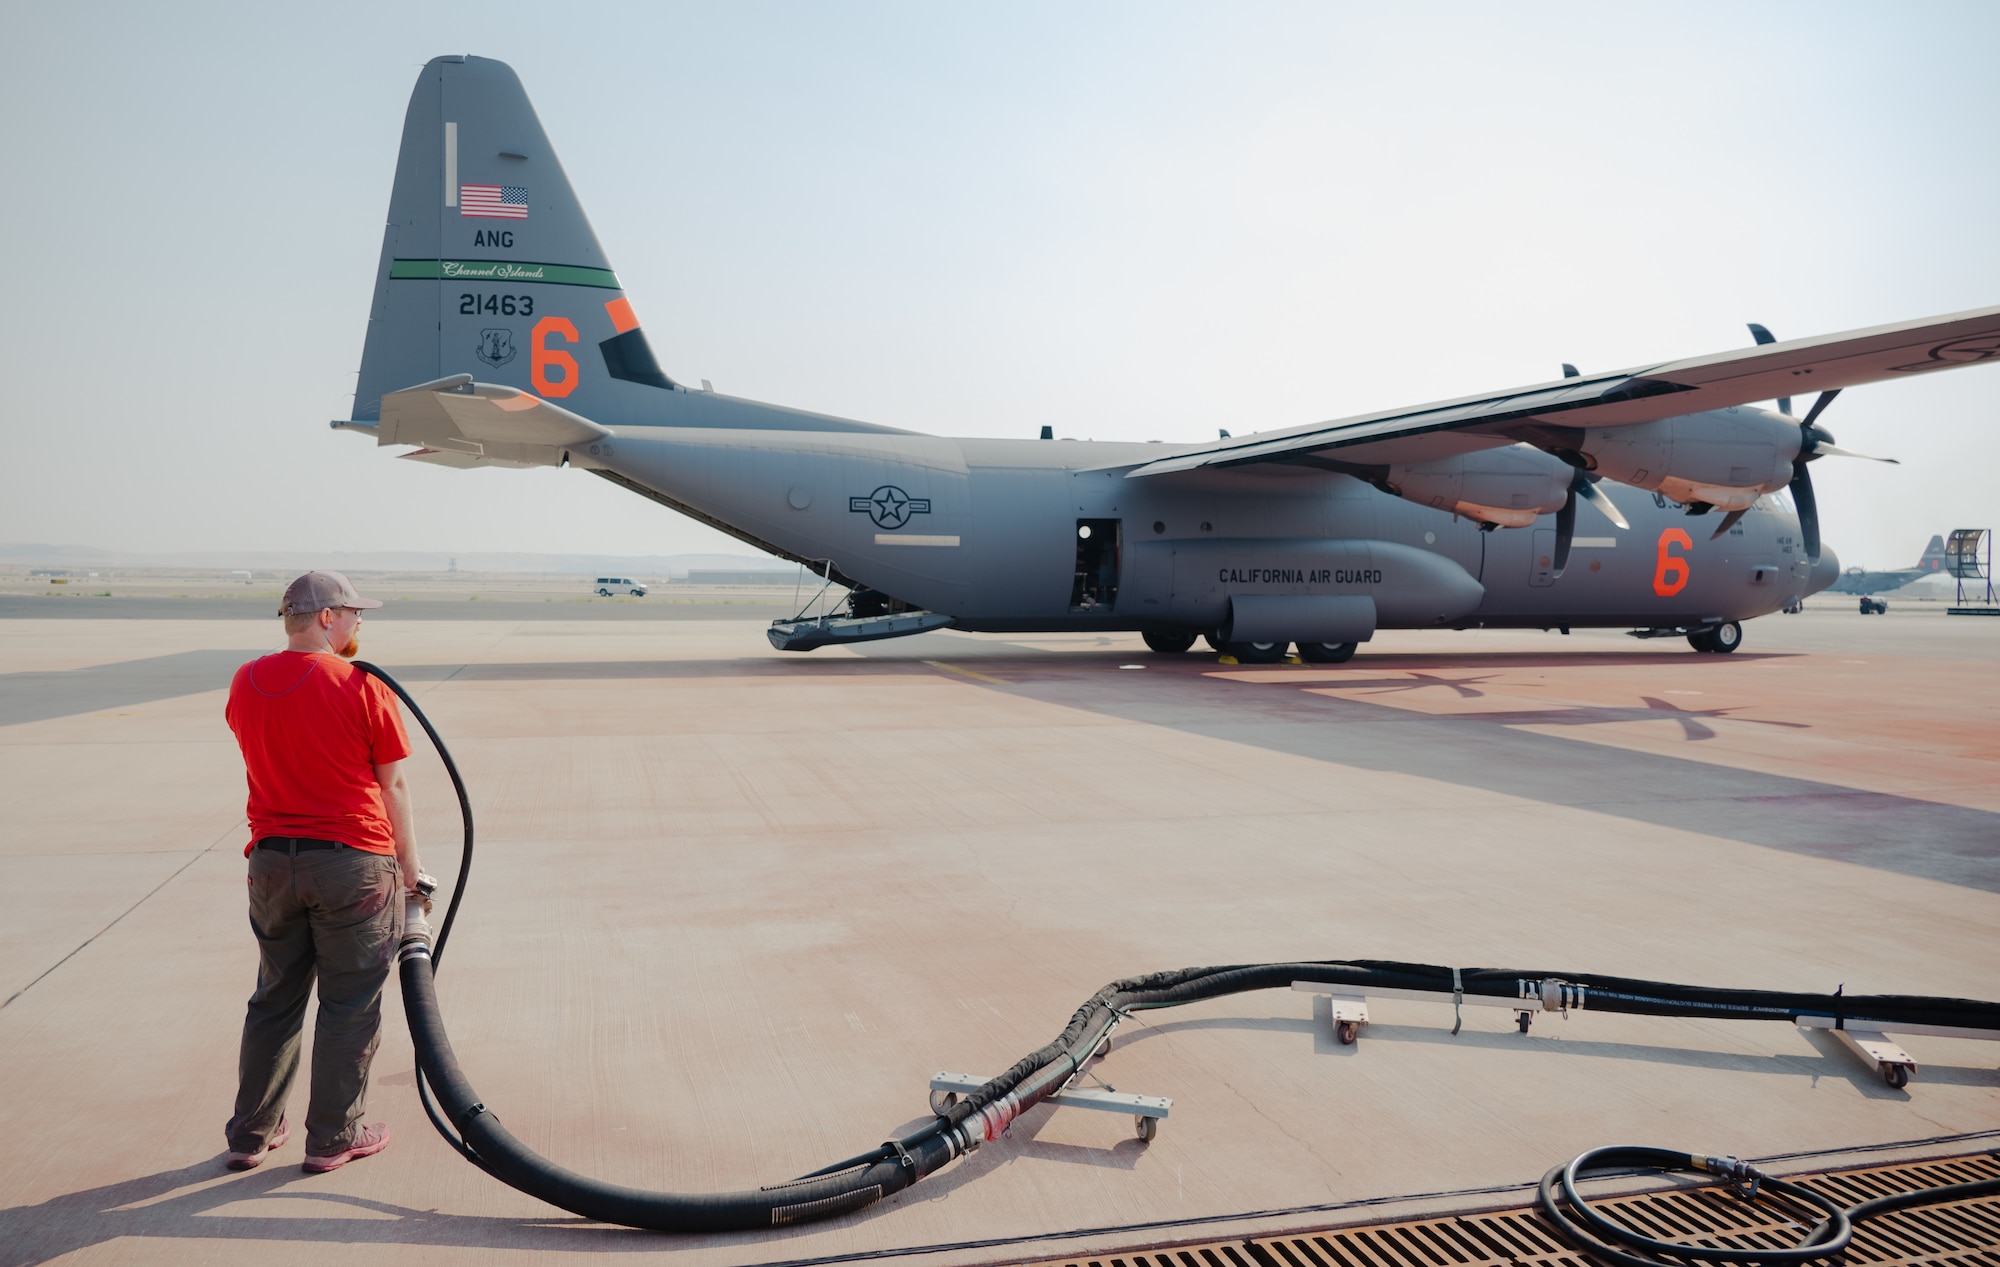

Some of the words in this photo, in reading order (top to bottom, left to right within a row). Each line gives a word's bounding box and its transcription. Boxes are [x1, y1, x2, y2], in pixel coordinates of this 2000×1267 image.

[474, 230, 514, 248] ANG
[443, 261, 497, 278] Channel
[497, 264, 544, 279] Islands
[459, 294, 534, 316] 21463
[531, 316, 579, 398] 6
[1652, 527, 1693, 597] 6
[1219, 569, 1304, 583] CALIFORNIA
[1308, 570, 1331, 583] AIR
[1335, 570, 1382, 583] GUARD
